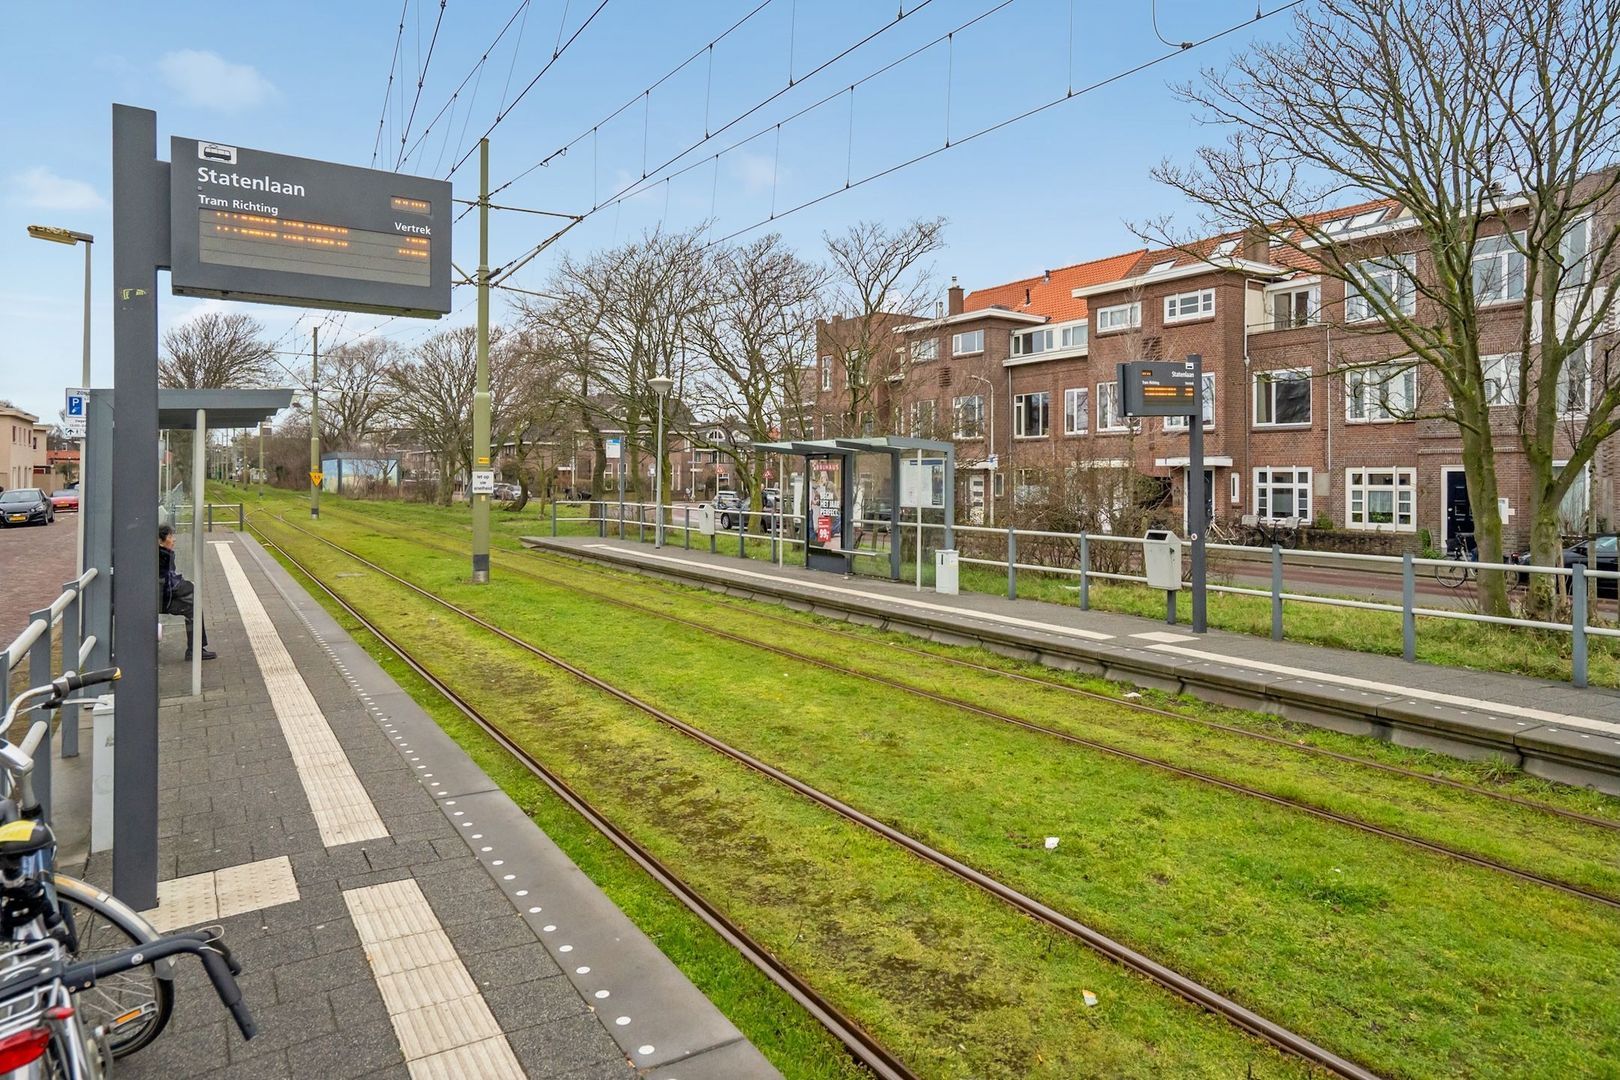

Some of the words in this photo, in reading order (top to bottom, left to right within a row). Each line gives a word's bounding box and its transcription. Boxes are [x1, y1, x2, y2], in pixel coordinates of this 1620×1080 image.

[198, 167, 305, 197] Statenlaan
[198, 194, 228, 207] Tram
[232, 200, 279, 216] Richting
[394, 222, 431, 235] Vertrek
[72, 398, 80, 407] P
